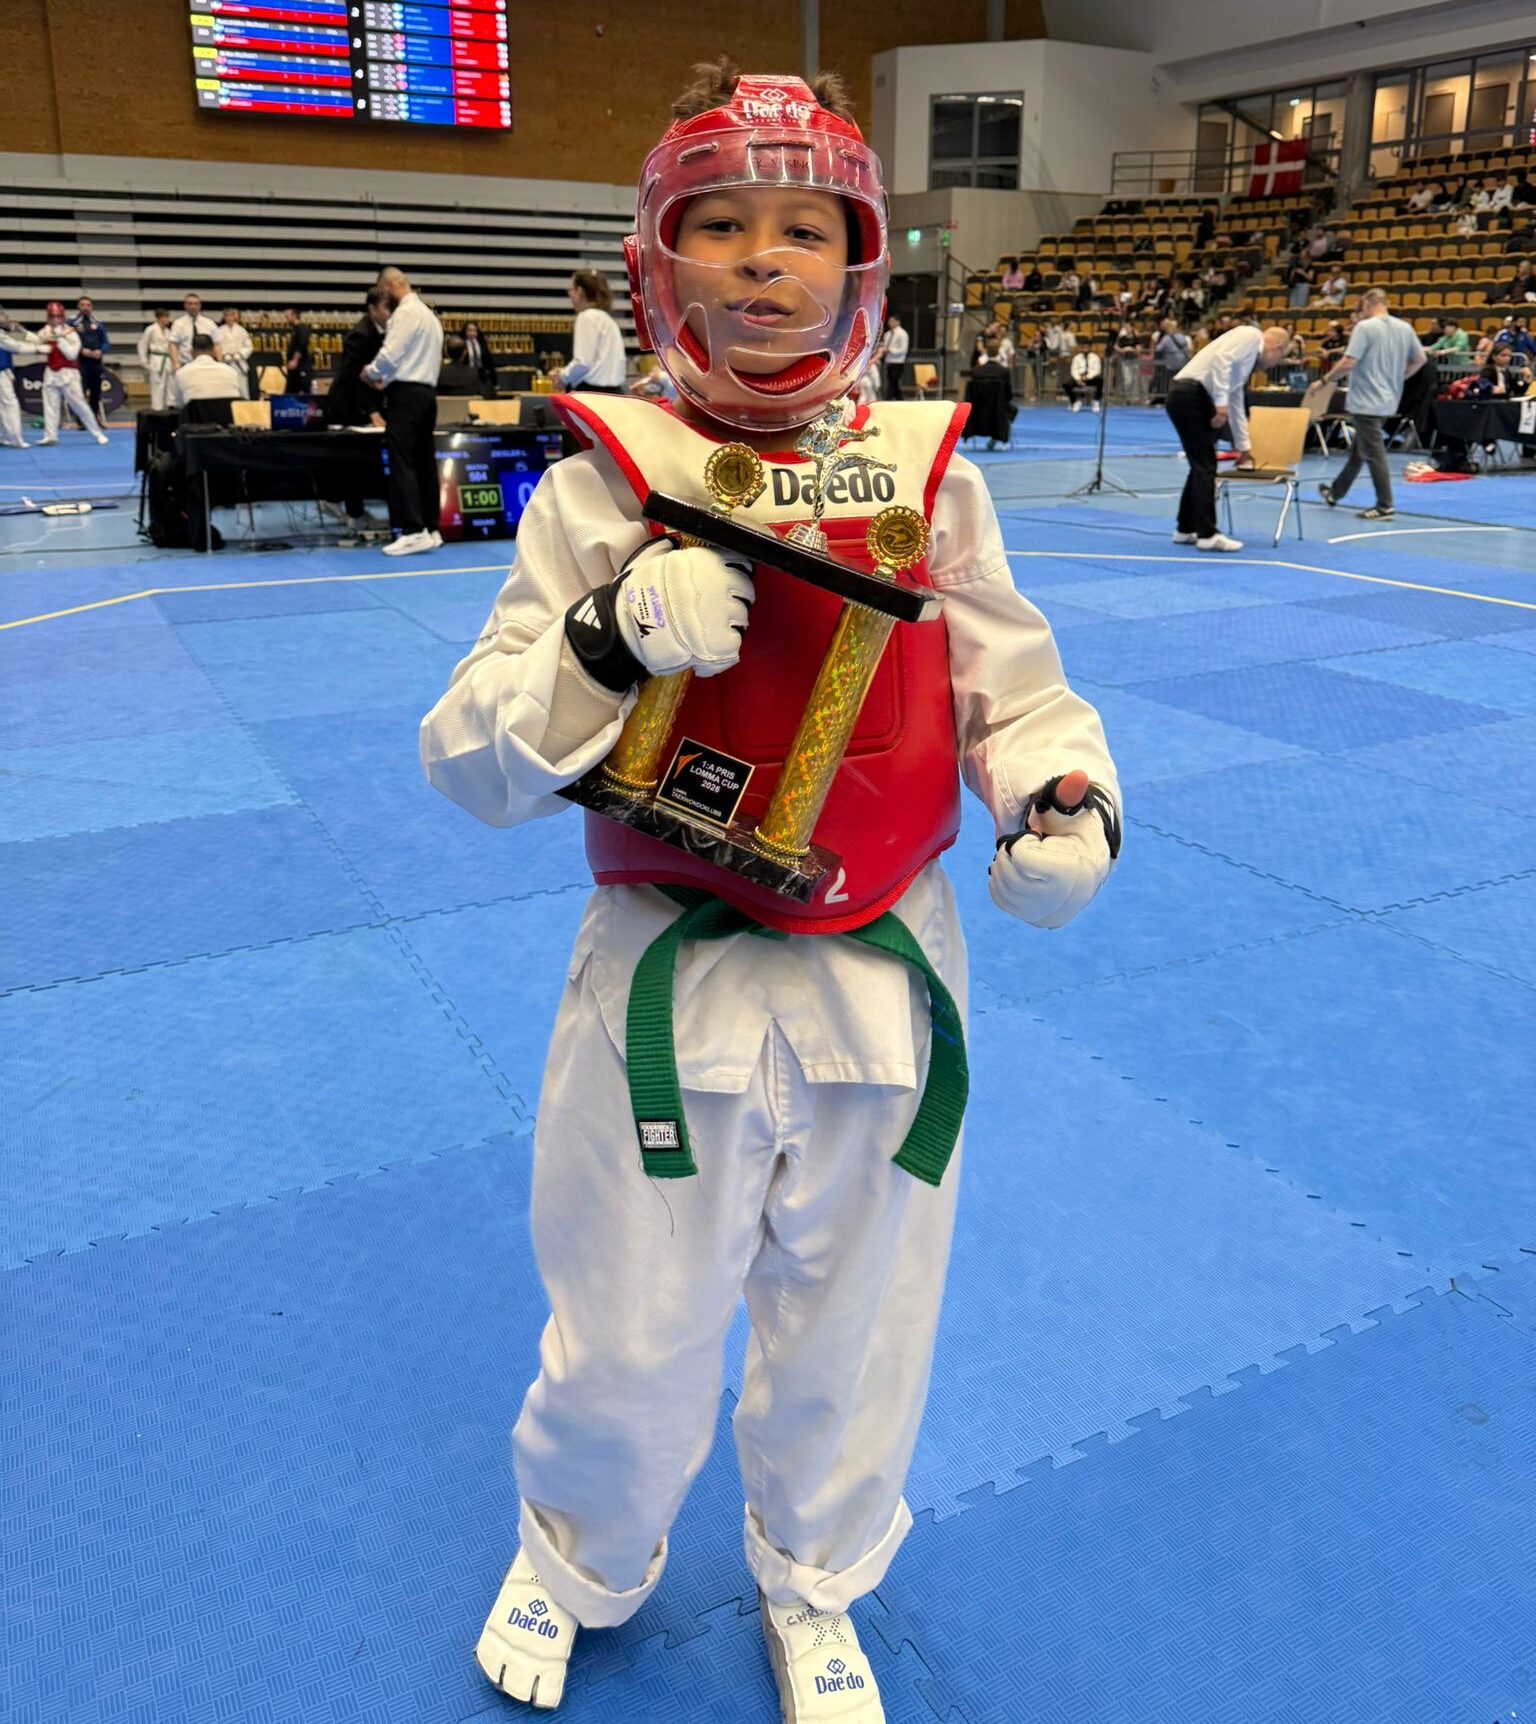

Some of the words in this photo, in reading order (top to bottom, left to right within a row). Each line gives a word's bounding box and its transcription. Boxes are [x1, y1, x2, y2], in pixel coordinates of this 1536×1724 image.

[464, 490, 498, 506] 1:00
[689, 765, 720, 784] LOMMA
[721, 778, 740, 791] CUP
[702, 760, 715, 772] 1:A
[715, 766, 736, 780] PRIS
[700, 779, 721, 794] 2026
[824, 866, 849, 904] 2
[642, 1129, 675, 1142] FIGHTER
